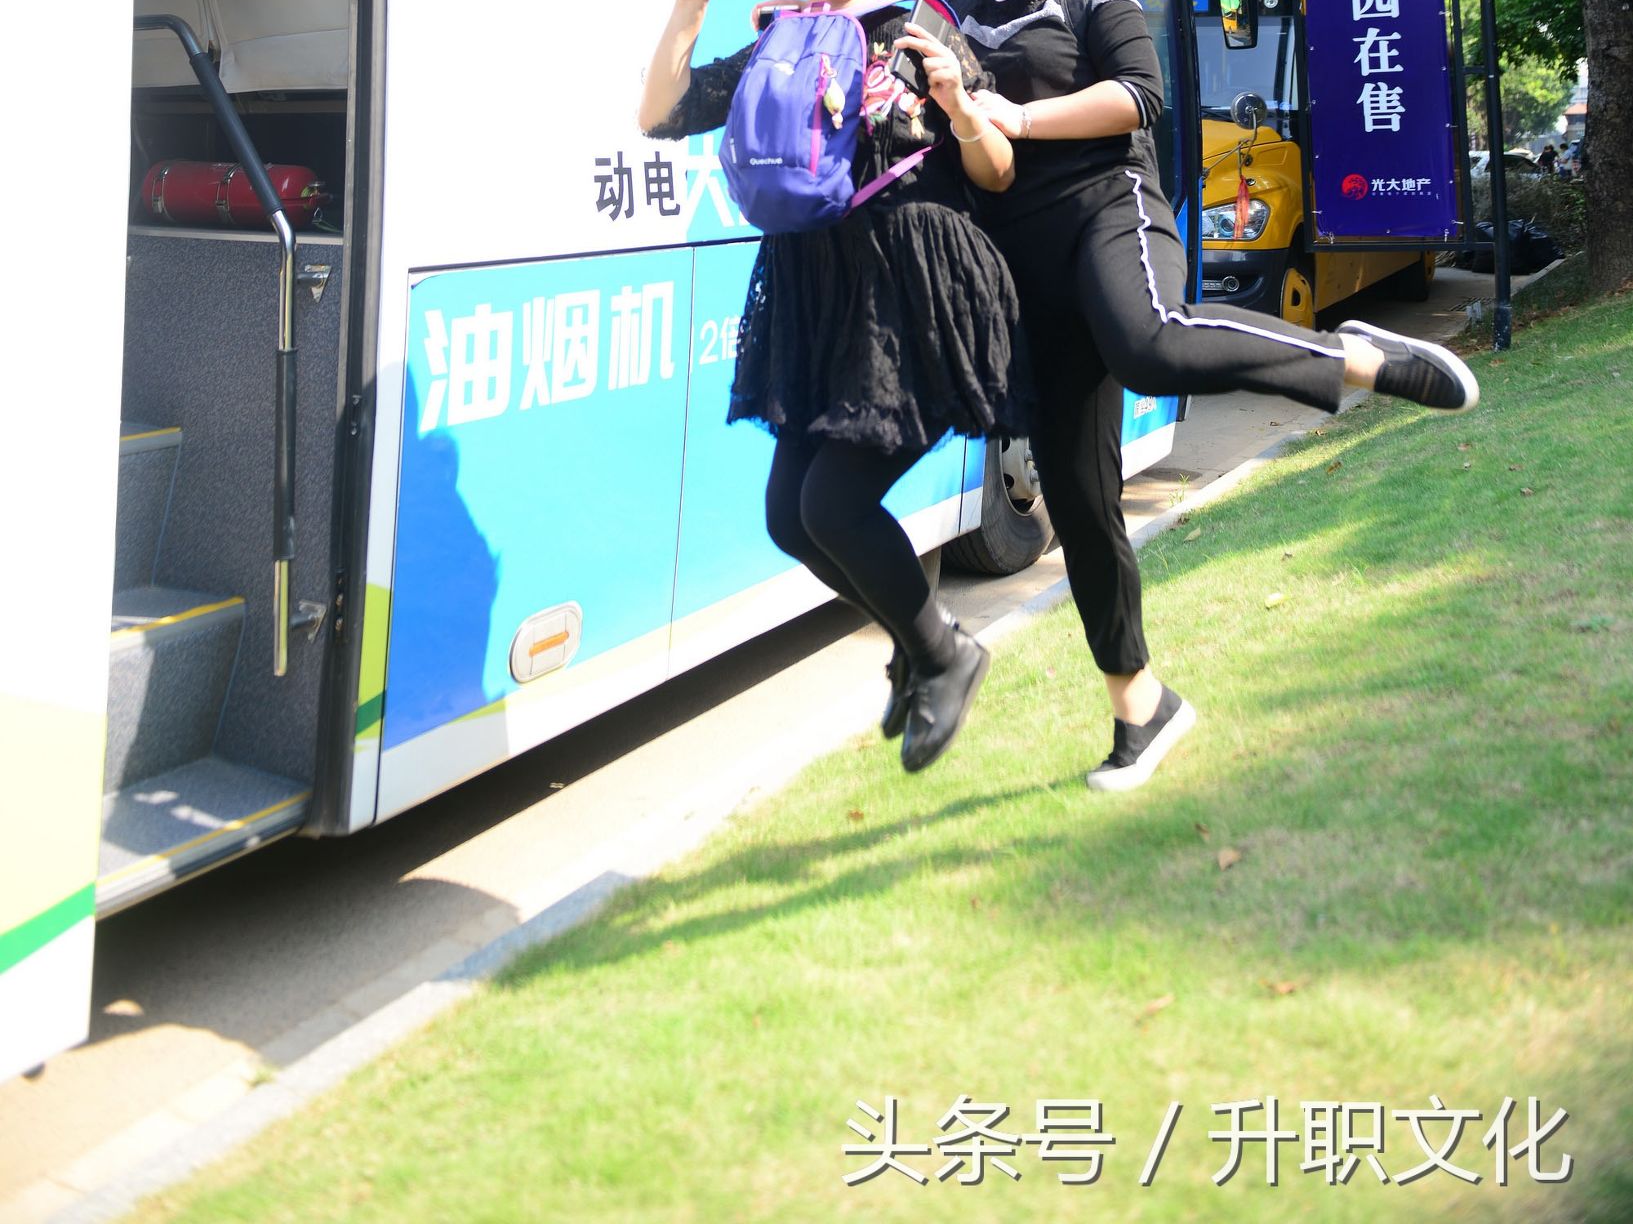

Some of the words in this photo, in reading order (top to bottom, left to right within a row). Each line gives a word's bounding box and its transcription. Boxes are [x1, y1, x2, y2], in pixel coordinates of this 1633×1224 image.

[1371, 178, 1431, 192] 光大地产
[419, 281, 675, 432] 油烟机
